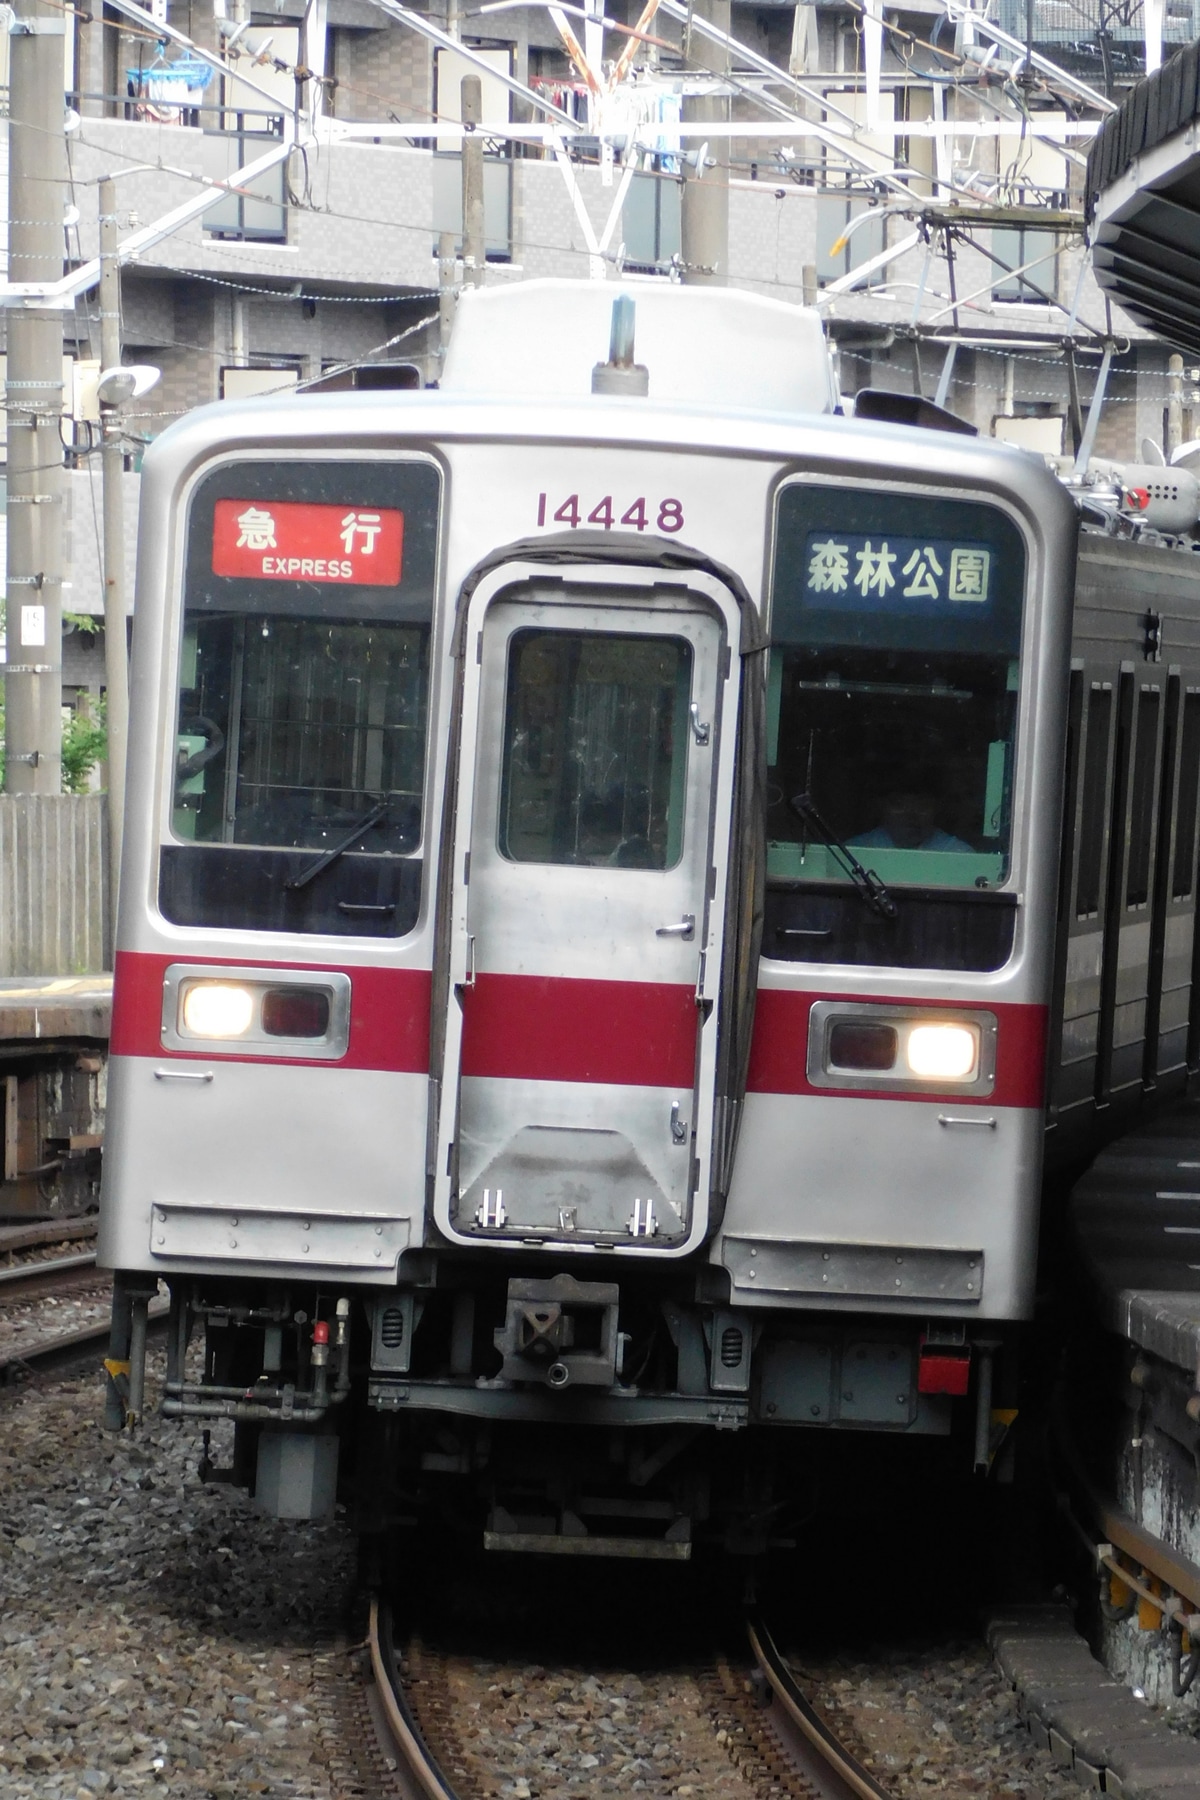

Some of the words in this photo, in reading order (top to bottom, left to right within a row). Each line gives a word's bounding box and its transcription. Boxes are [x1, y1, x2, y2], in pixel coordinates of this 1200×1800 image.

[538, 493, 684, 533] 14448
[261, 556, 353, 579] EXPRESS
[807, 538, 990, 602] 森林公園
